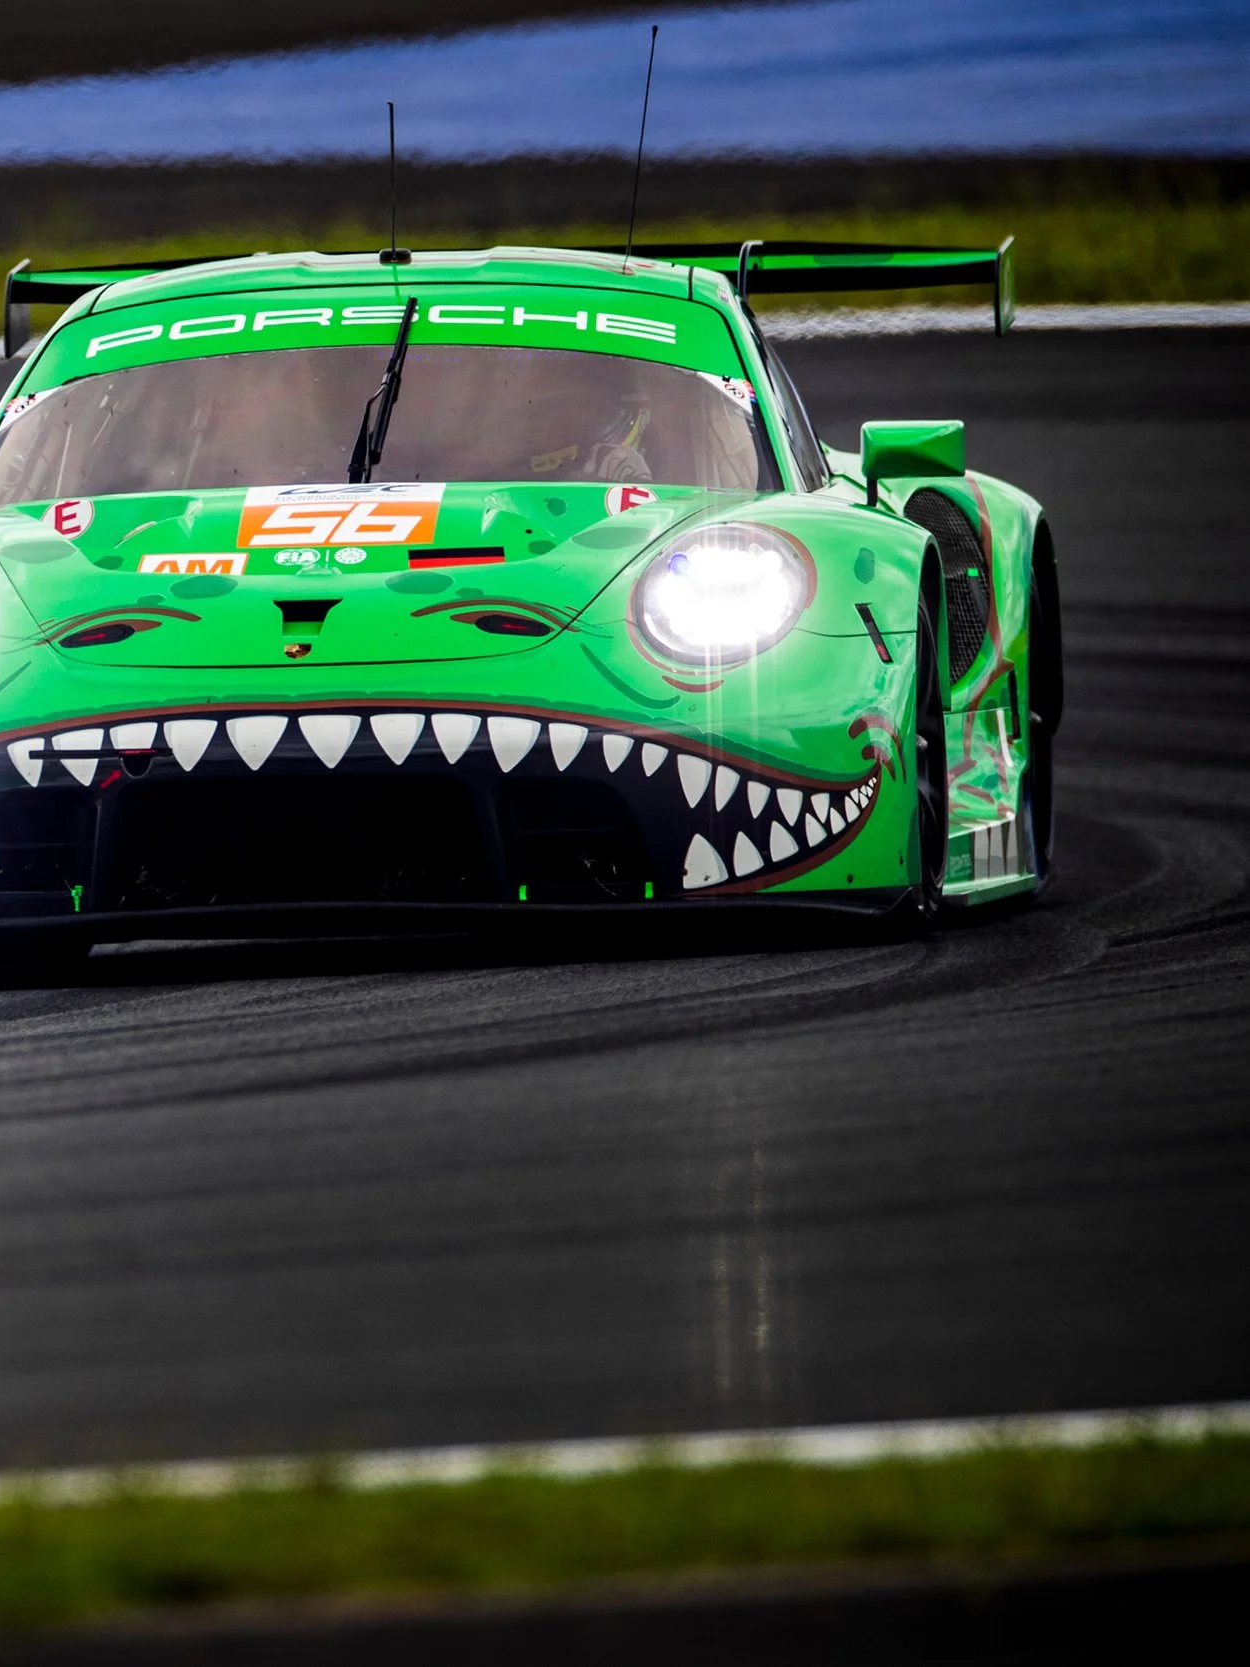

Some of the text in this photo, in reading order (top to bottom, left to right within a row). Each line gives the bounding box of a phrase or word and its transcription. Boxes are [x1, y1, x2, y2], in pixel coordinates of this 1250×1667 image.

[85, 304, 676, 359] PORSCHE
[54, 500, 81, 535] E
[249, 502, 422, 546] 56
[153, 559, 235, 575] AM
[276, 549, 317, 563] FIA
